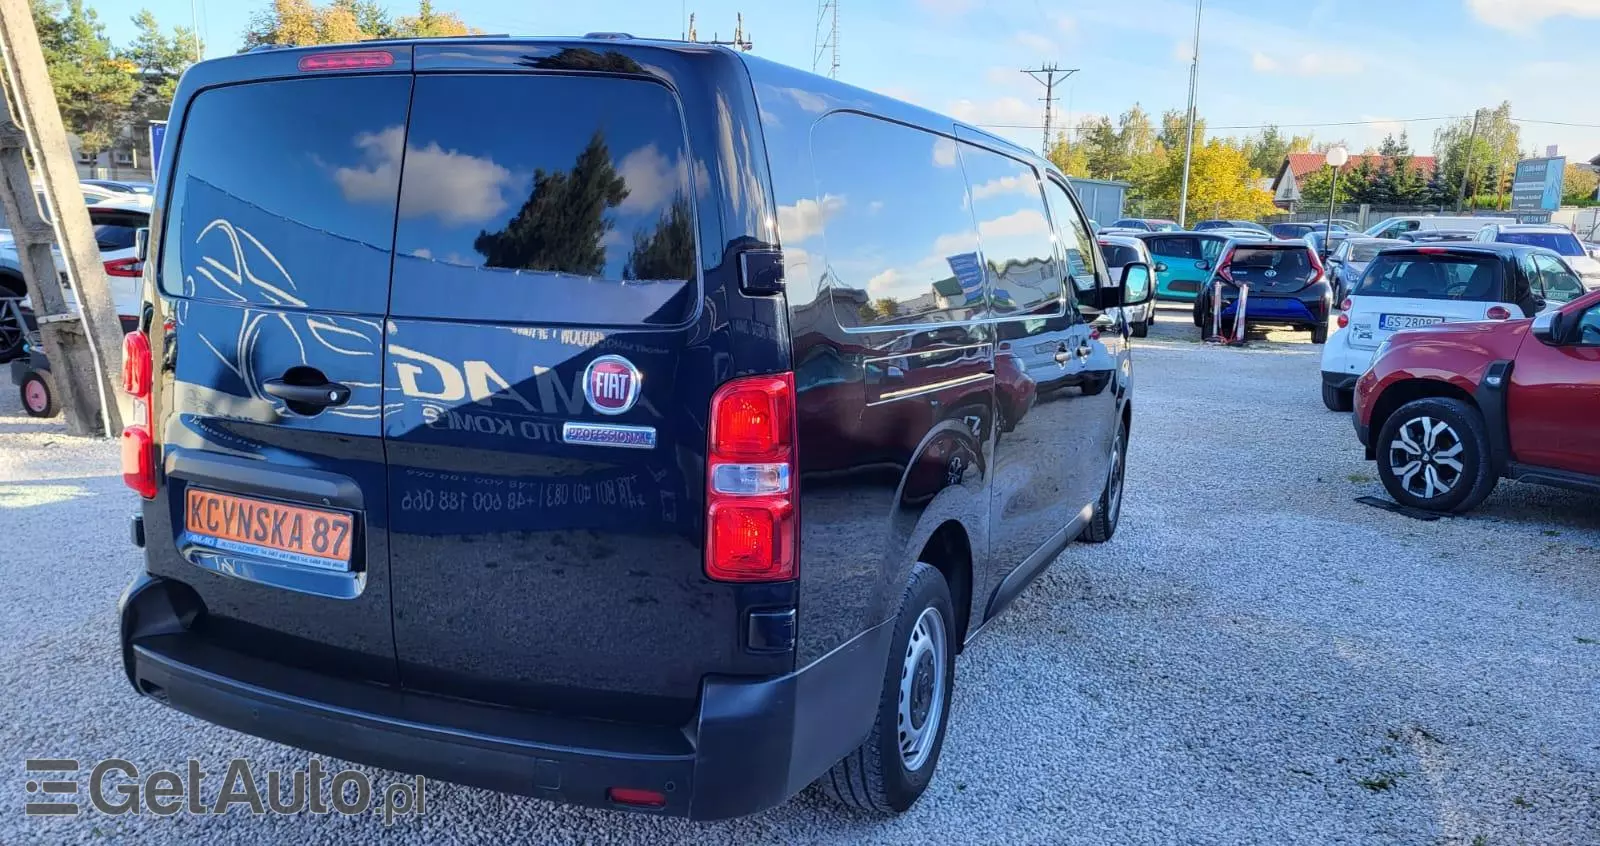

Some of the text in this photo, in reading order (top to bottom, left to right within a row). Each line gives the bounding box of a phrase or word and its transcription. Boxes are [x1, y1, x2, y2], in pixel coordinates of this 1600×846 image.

[1387, 316, 1401, 327] GS
[595, 370, 629, 400] FIAT
[568, 427, 649, 445] PROFESSIONAL
[190, 494, 350, 556] KCYNSKA 87
